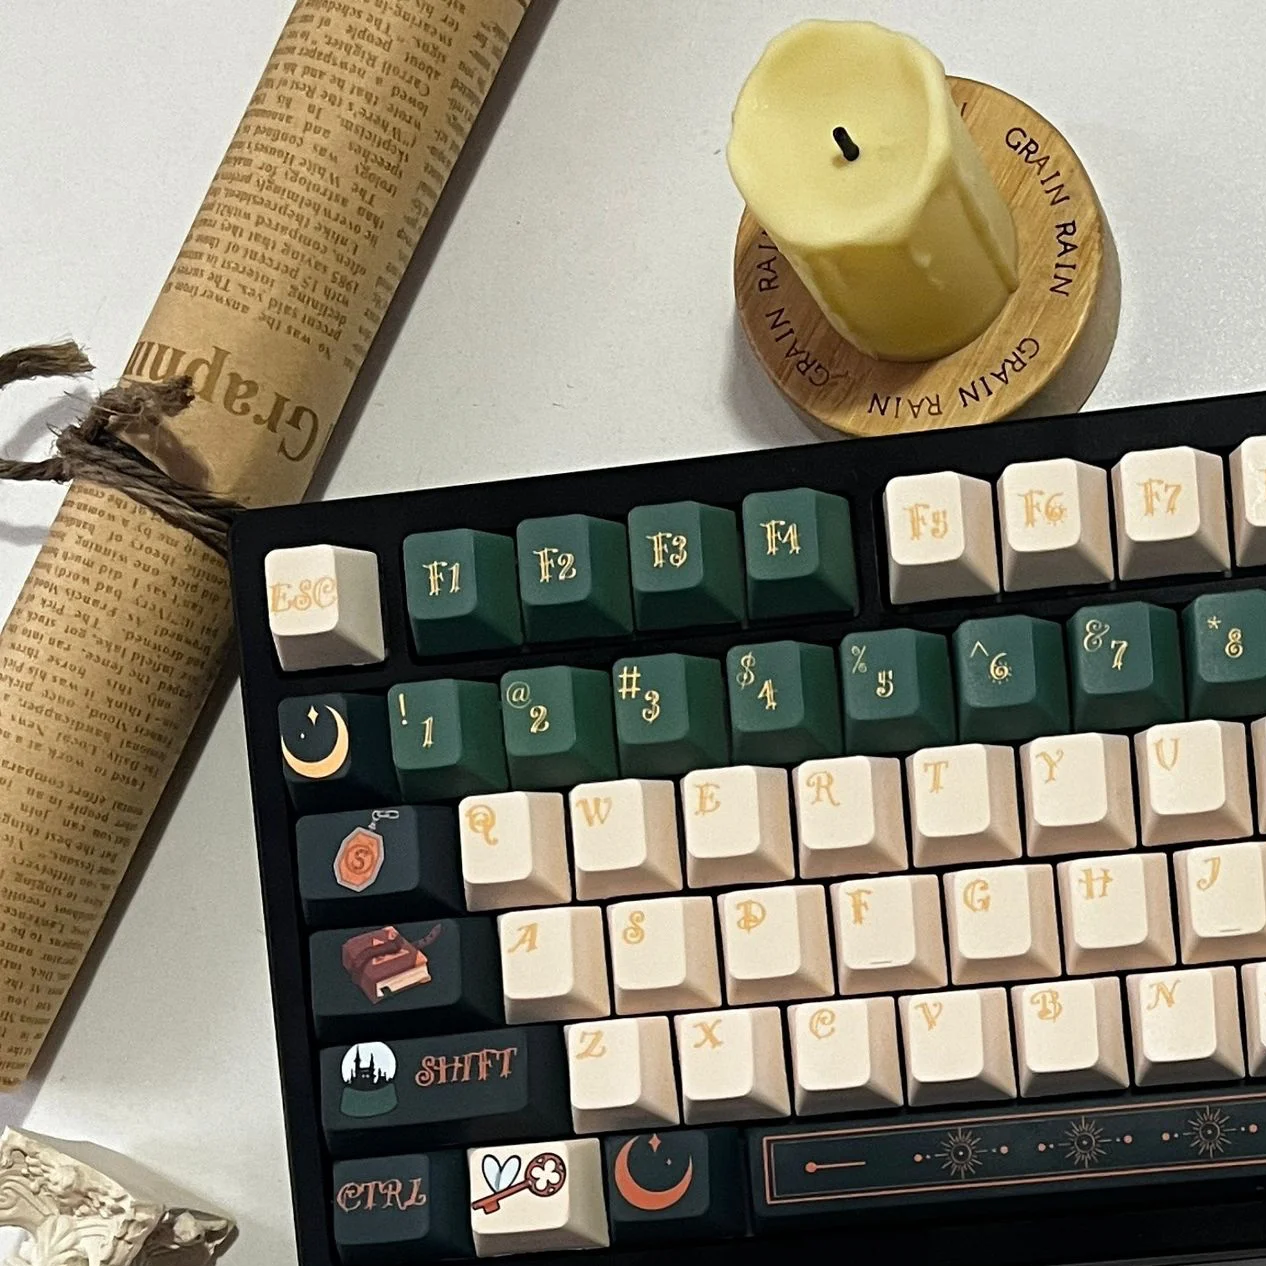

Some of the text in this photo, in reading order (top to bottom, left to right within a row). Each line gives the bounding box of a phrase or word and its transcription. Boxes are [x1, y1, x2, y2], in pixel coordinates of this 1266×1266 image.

[343, 23, 393, 53] people
[300, 64, 326, 83] and
[348, 83, 380, 107] that
[384, 101, 423, 130] wrote
[1005, 126, 1078, 298] GRAIN RAIN
[245, 229, 277, 252] that
[253, 213, 329, 257] compared
[329, 270, 360, 295] 1985
[757, 230, 830, 388] GRAIN RAI
[867, 336, 1040, 420] GRAIN RAIN
[1017, 489, 1067, 528] F6
[1137, 478, 1182, 517] F7
[904, 503, 949, 541] F5
[72, 533, 129, 567] winning
[533, 547, 576, 584] F2
[645, 531, 688, 569] F3
[131, 559, 160, 578] one
[422, 561, 460, 597] F1
[93, 580, 123, 601] bad
[271, 576, 336, 614] ESC
[1109, 640, 1129, 671] 7
[1224, 628, 1244, 660] 8
[987, 652, 1012, 685] 6
[529, 705, 550, 734] 2
[641, 690, 661, 724] 3
[420, 716, 434, 749] 1
[923, 760, 949, 793] T
[1034, 748, 1064, 784] Y
[694, 783, 721, 816] E
[805, 770, 842, 808] R
[575, 797, 612, 828] W
[1077, 867, 1114, 900] H
[1196, 856, 1222, 891] J
[845, 888, 873, 925] F
[963, 879, 990, 913] G
[622, 910, 645, 945] S
[736, 900, 767, 933] D
[508, 922, 539, 953] A
[1030, 989, 1063, 1023] B
[1146, 979, 1181, 1011] N
[809, 1008, 836, 1041] C
[914, 1000, 943, 1032] V
[575, 1030, 607, 1061] Z
[694, 1019, 724, 1050] X
[415, 1047, 518, 1088] SHIFT
[337, 1178, 426, 1213] CTRL
